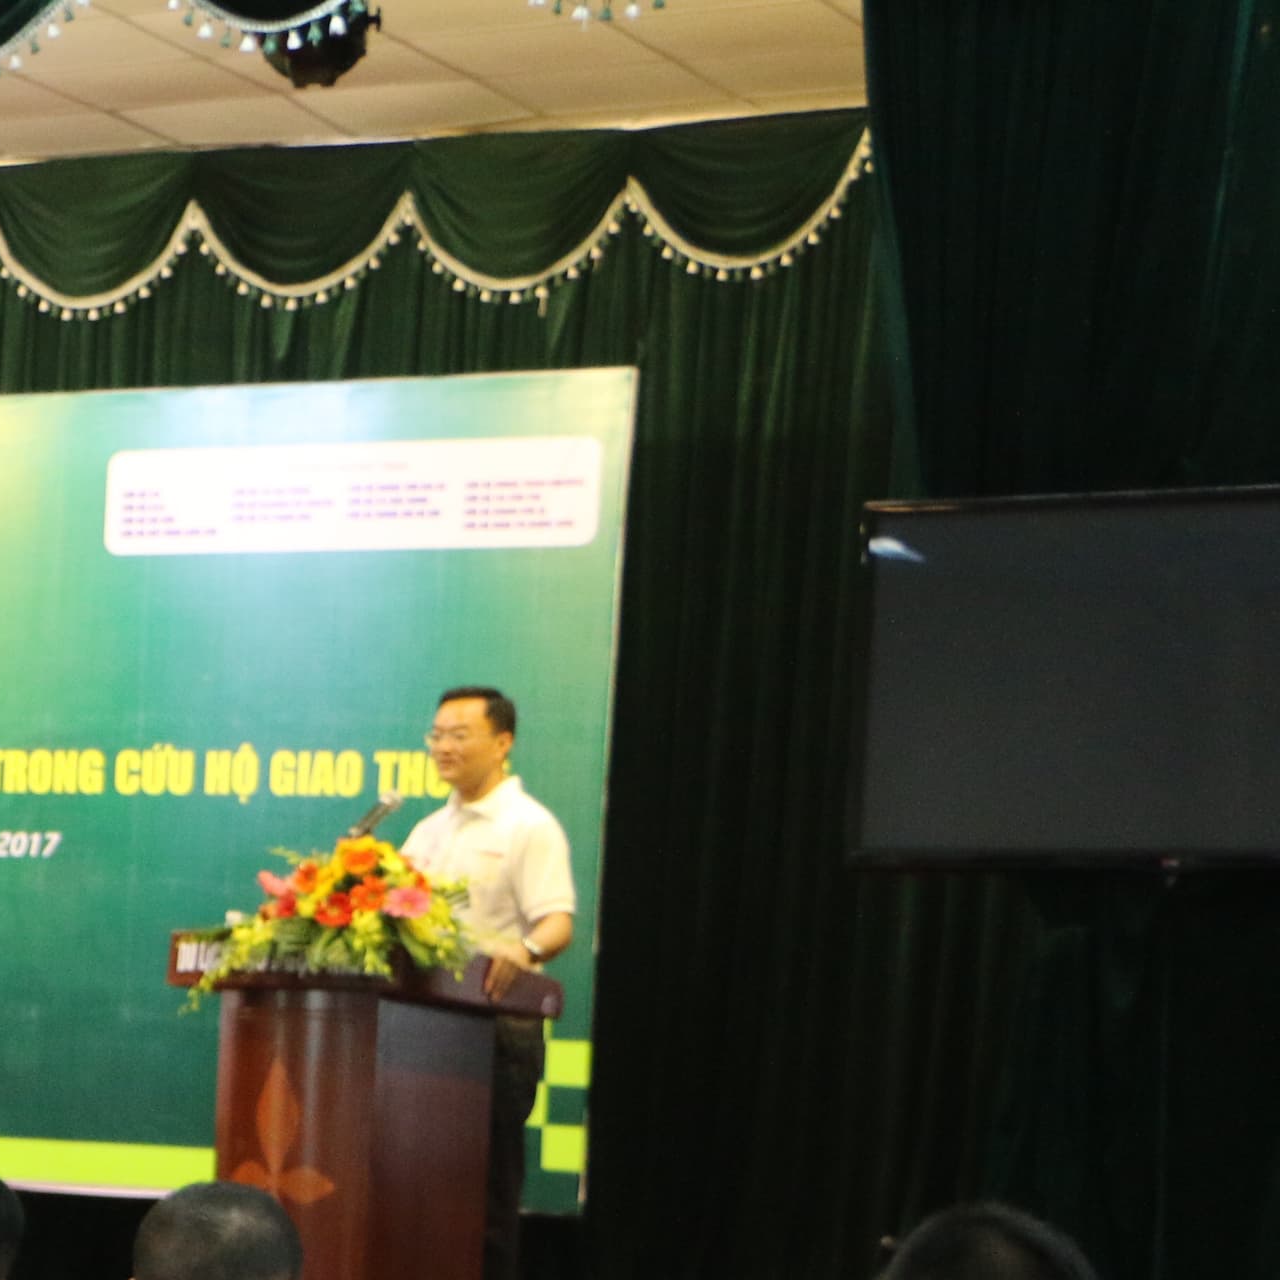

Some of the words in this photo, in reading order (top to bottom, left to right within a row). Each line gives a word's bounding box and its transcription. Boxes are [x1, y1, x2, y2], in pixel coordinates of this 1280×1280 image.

[115, 743, 195, 796] CỨU
[204, 743, 256, 803] HỘ
[270, 750, 362, 798] GIAO
